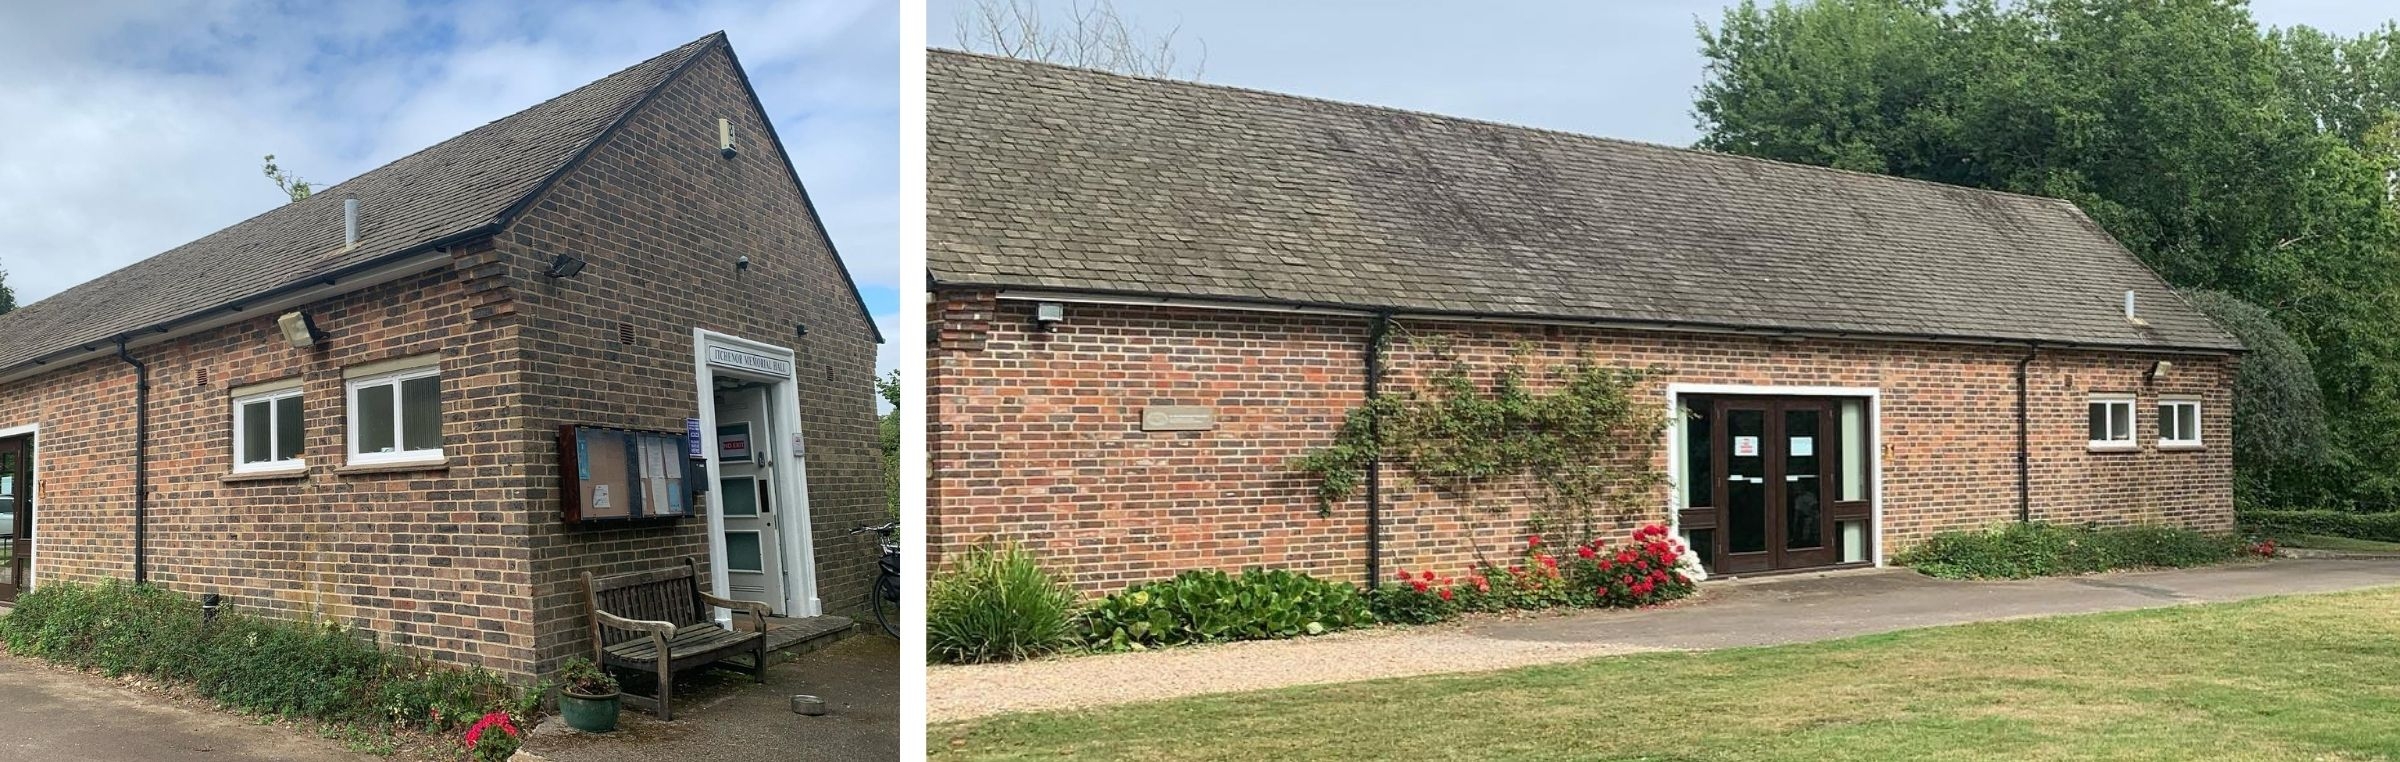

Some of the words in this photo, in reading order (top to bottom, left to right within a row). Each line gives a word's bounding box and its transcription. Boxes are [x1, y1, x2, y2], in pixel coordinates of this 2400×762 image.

[715, 349, 743, 365] ITCHENOR
[744, 355, 772, 370] MEMORIAL
[773, 361, 787, 373] HALL
